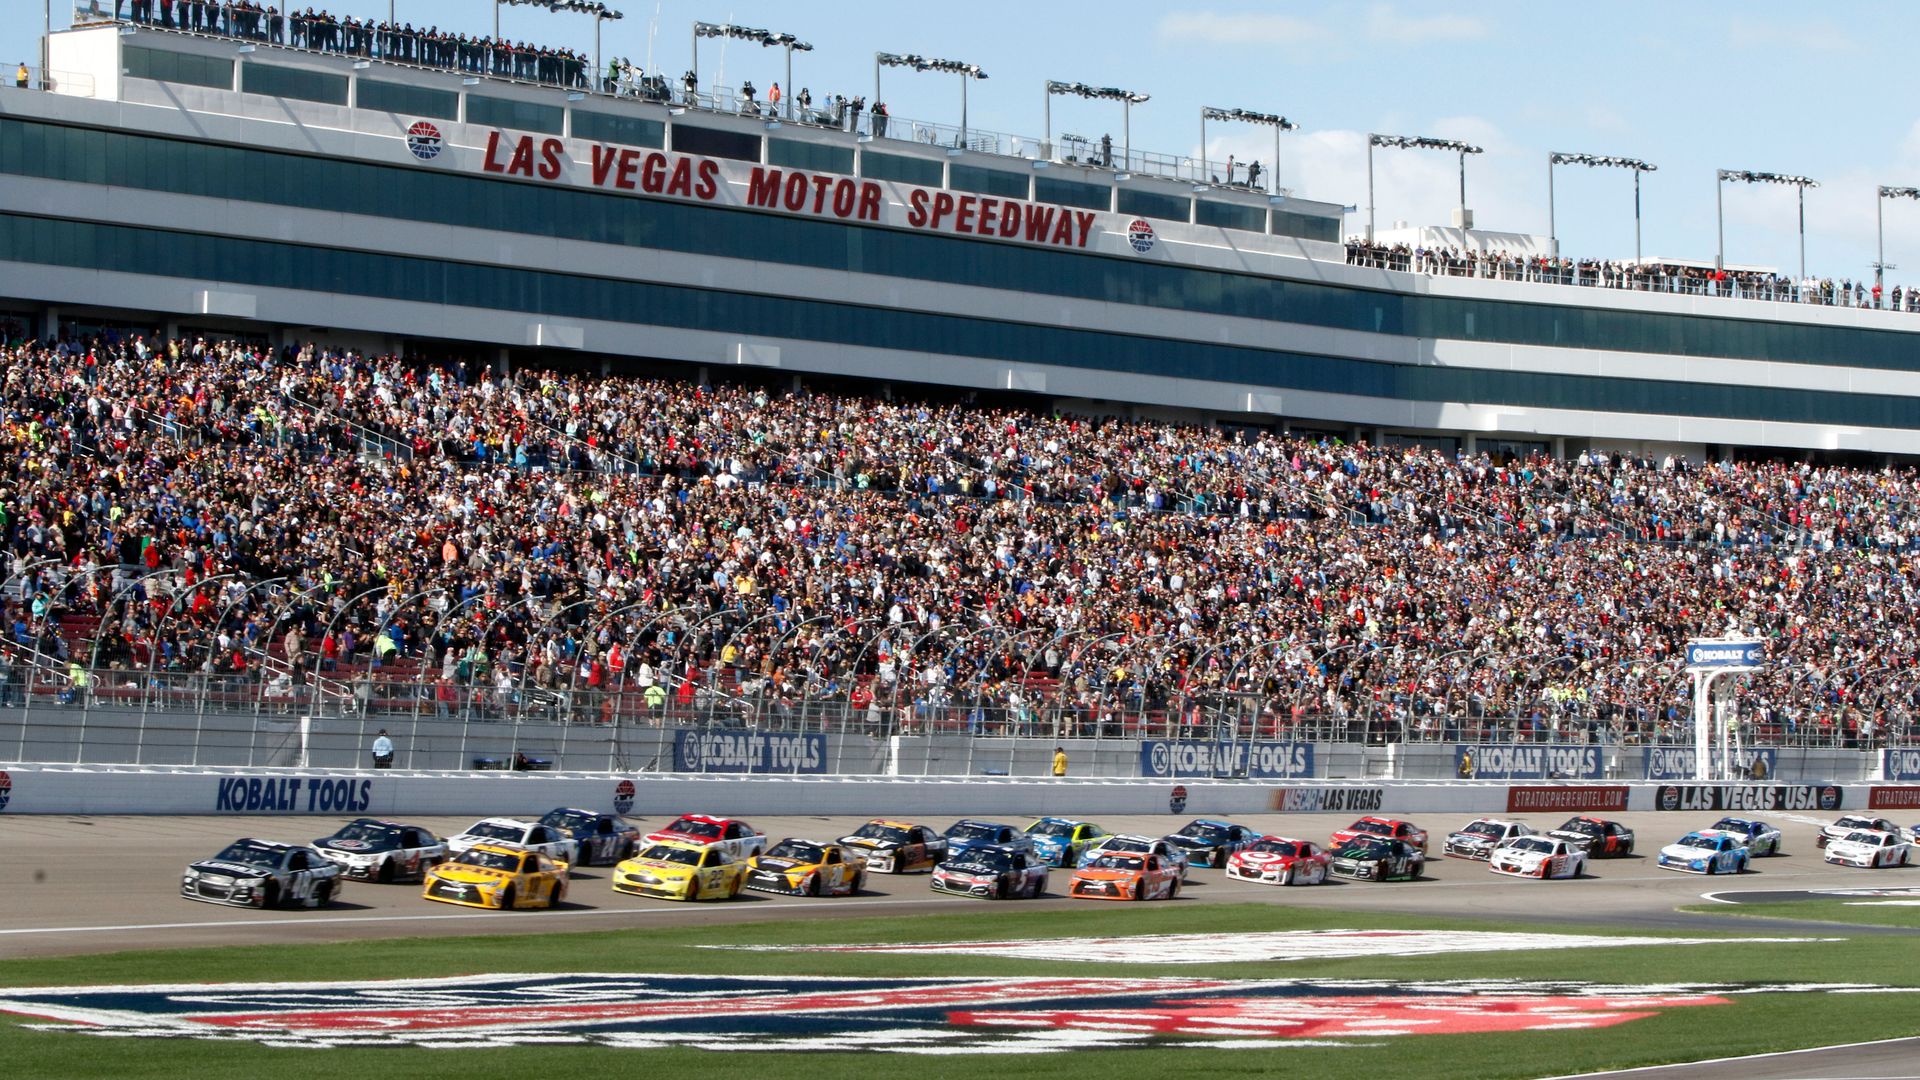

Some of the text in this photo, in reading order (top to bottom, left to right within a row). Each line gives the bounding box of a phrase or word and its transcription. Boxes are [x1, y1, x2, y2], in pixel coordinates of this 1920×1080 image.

[484, 131, 1096, 247] LAS VEGAS MOTOR SPEEDWAY
[1703, 649, 1744, 660] KOBALT
[700, 734, 765, 767] KOBALT
[770, 736, 820, 768] TOOLS
[1170, 744, 1243, 772] KOBALT
[1251, 746, 1306, 773] TOOLS
[1480, 747, 1596, 774] KOBALT TOOLS
[1665, 750, 1721, 773] KOBLT
[216, 777, 371, 812] KOBALT TOOLS
[1283, 788, 1383, 811] NASCAR LAS VEGAS
[1514, 790, 1623, 807] STRATOSPHEREHOTEL.COM
[1680, 786, 1818, 810] LAS VEGAS USA
[841, 836, 900, 849] CAT
[291, 869, 312, 899] 48
